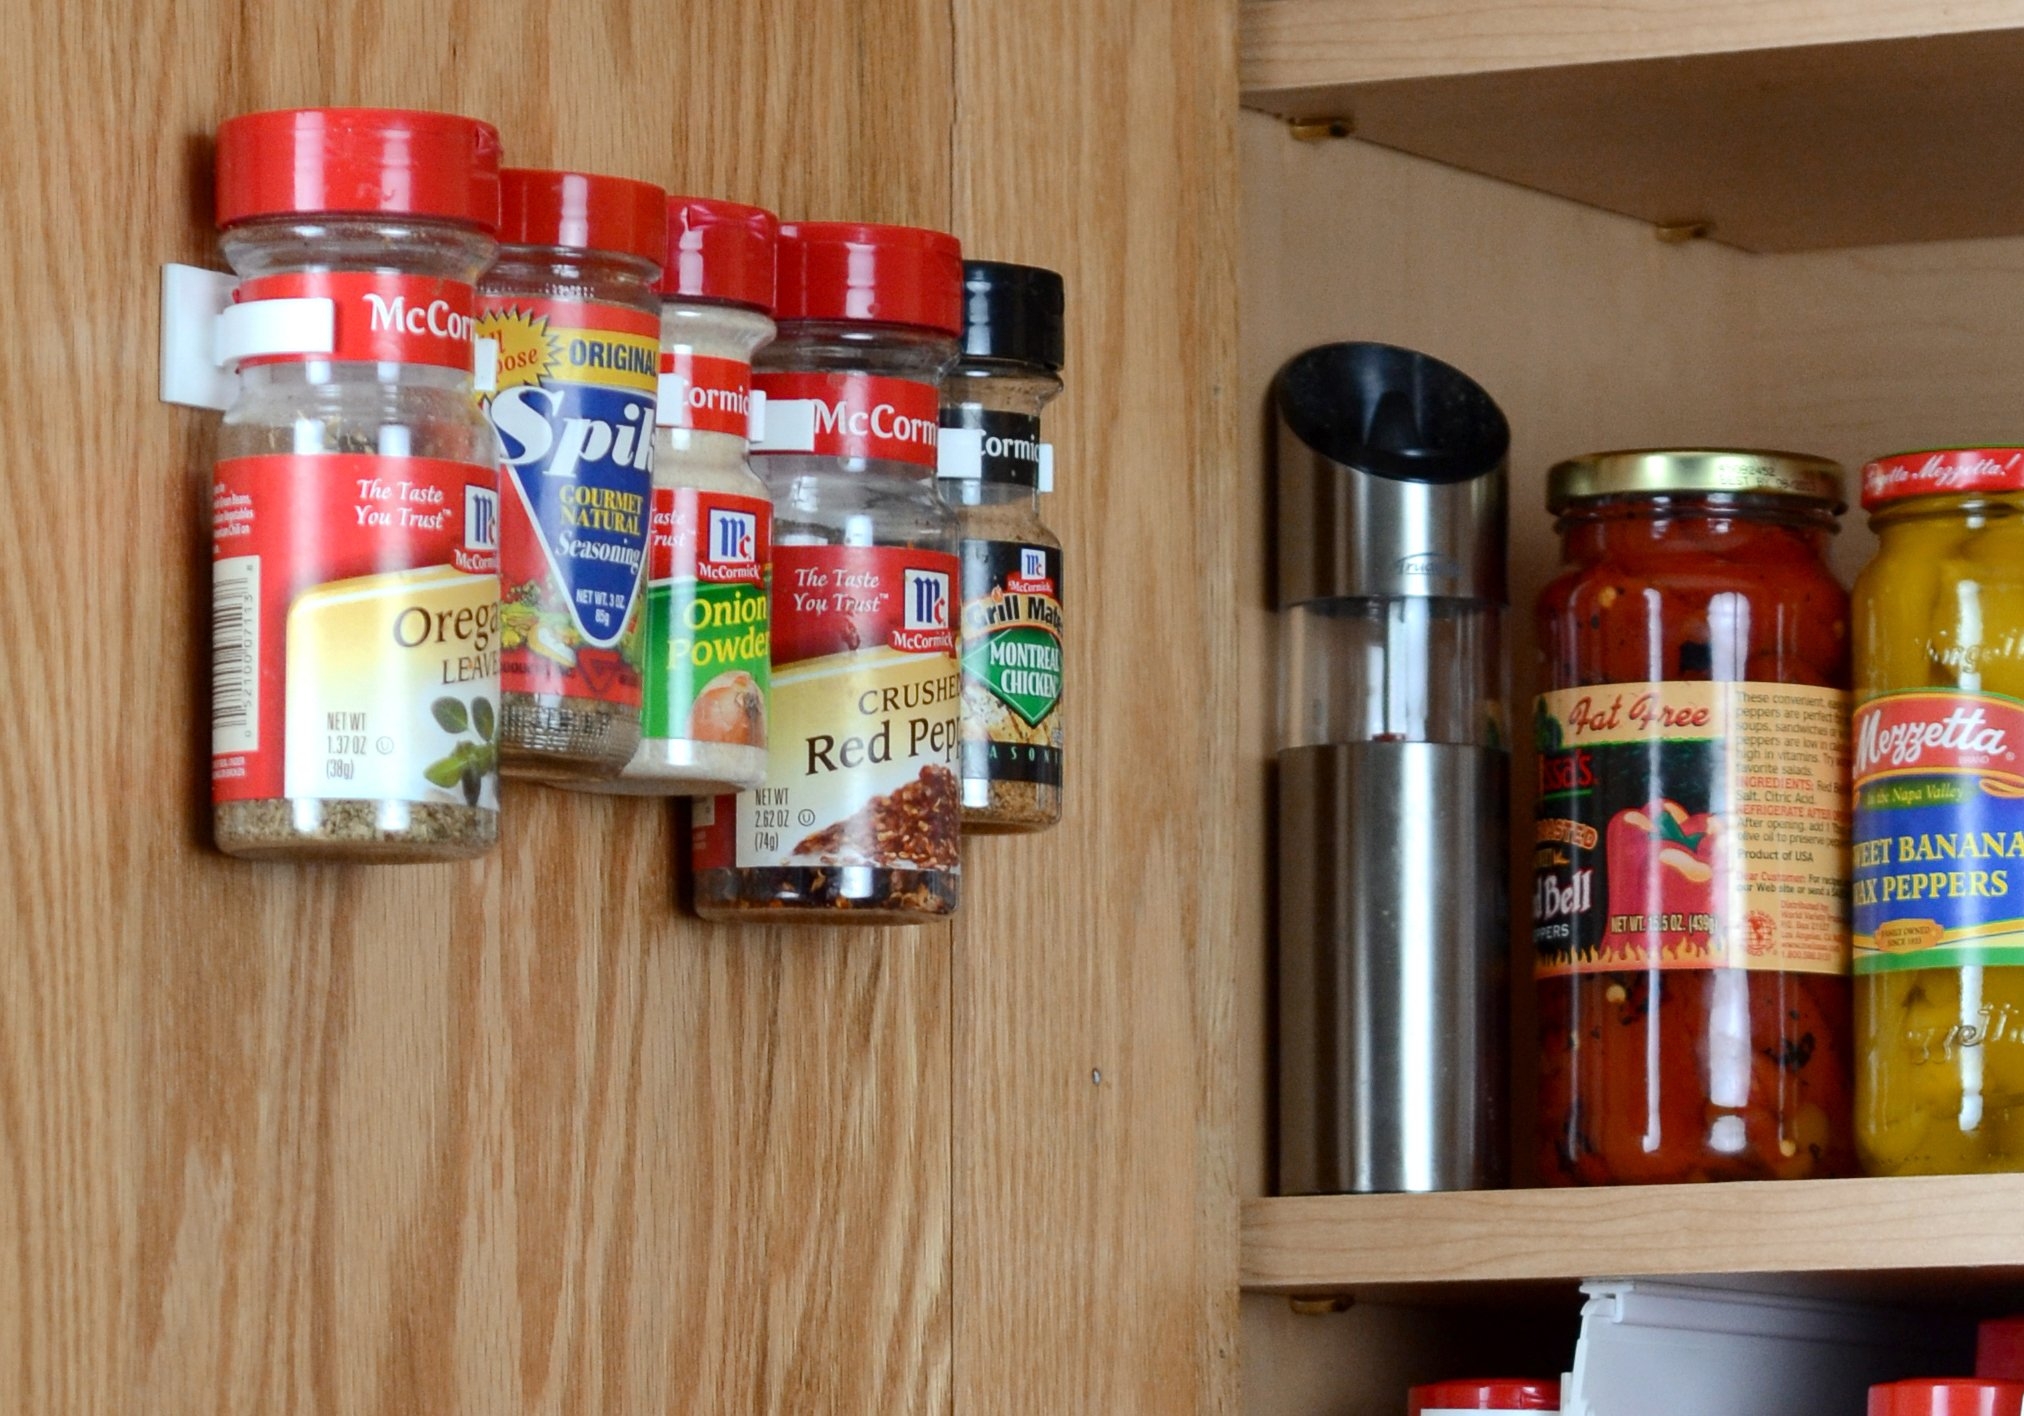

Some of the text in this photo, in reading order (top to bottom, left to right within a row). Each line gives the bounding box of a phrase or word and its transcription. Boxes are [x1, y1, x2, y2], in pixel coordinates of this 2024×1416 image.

[356, 478, 443, 503] The Taste
[559, 484, 644, 515] GOURMET
[355, 505, 390, 526] You
[559, 505, 641, 537] NATURAL
[554, 529, 641, 576] Seasoning
[698, 562, 760, 580] McCormick
[795, 566, 881, 589] The Taste
[576, 588, 594, 604] NET
[609, 592, 616, 607] 3
[793, 591, 829, 615] You
[594, 609, 611, 627] 85g
[682, 590, 767, 631] Onion
[966, 594, 1020, 626] Grill
[892, 630, 954, 650] McCormick
[989, 640, 1060, 671] MONTREAL
[1000, 668, 1060, 699] CHICKEN
[1736, 690, 1770, 704] These
[326, 711, 367, 732] NET WT
[1568, 691, 1711, 736] Fat Free
[1736, 707, 1781, 720] peppers
[1784, 710, 1800, 719] are
[327, 735, 367, 756] 1.37 OZ
[804, 719, 893, 776] Red
[1736, 736, 1781, 748] peppers
[1784, 738, 1800, 748] are
[1852, 706, 2008, 781] Mezzetta
[1764, 749, 1774, 759] in
[326, 759, 355, 780] (38g)
[1736, 762, 1779, 775] favorite
[755, 787, 790, 806] NET WT
[1764, 790, 1792, 803] Citric
[1891, 784, 1923, 804] Napa
[1927, 780, 1963, 803] Valley
[755, 809, 790, 829] 2.62 OZ
[1736, 803, 1805, 818] REFRIGERATE
[1737, 816, 1763, 829] After
[755, 831, 779, 852] (74g)
[1762, 831, 1775, 842] oil
[1776, 832, 1787, 842] to
[1898, 830, 2024, 862] BANANA
[1737, 847, 1814, 861] Product of USA
[1544, 869, 1593, 919] Bell
[1756, 882, 1777, 893] Web
[1882, 870, 2009, 902] PEPPERS
[1610, 915, 1628, 934] NET
[1628, 915, 1647, 933] WT.
[1670, 913, 1687, 931] OZ.
